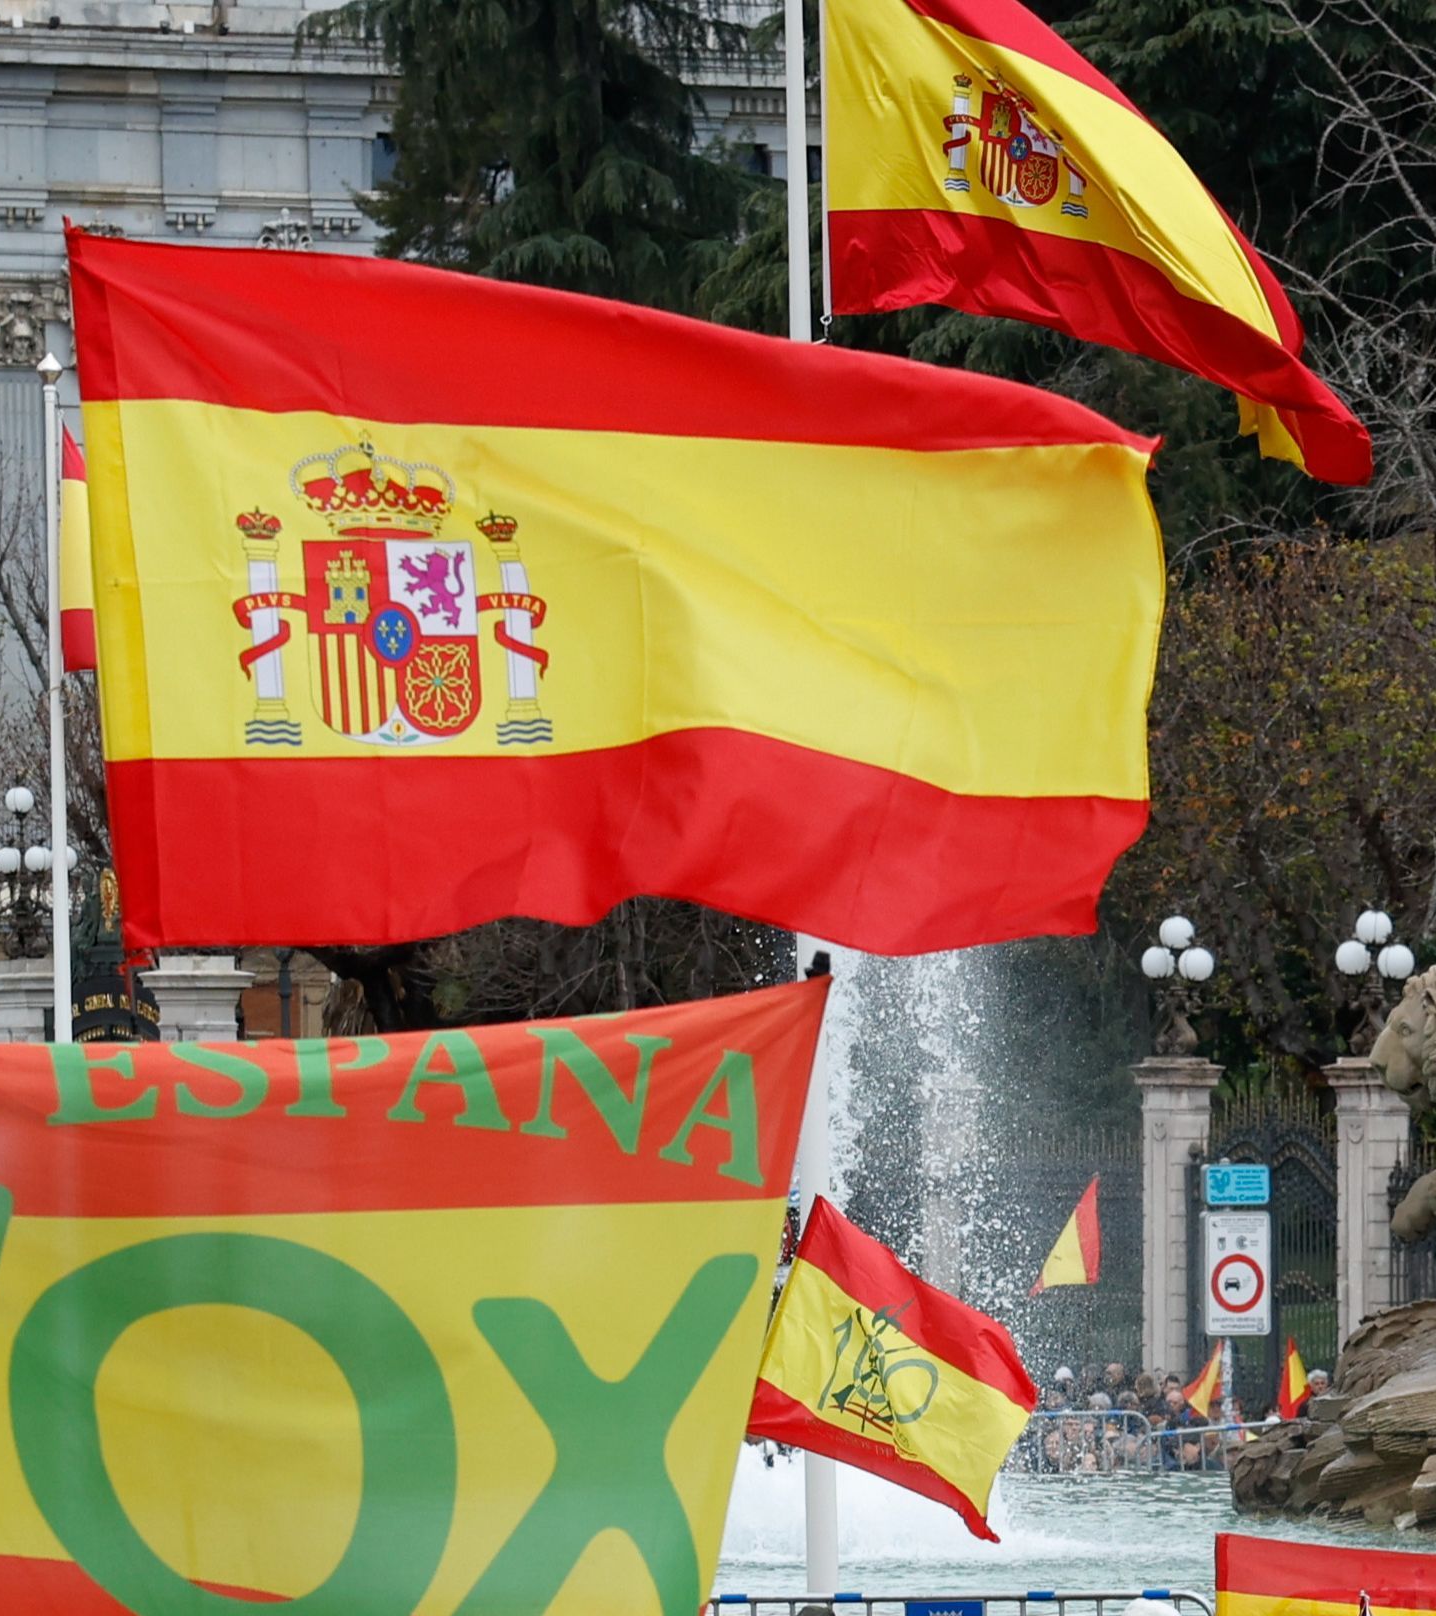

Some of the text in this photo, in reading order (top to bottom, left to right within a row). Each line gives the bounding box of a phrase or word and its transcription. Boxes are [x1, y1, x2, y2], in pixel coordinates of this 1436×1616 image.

[244, 594, 292, 611] PLVS
[488, 594, 542, 614] VLTRA
[46, 1016, 766, 1189] ESPAÑA
